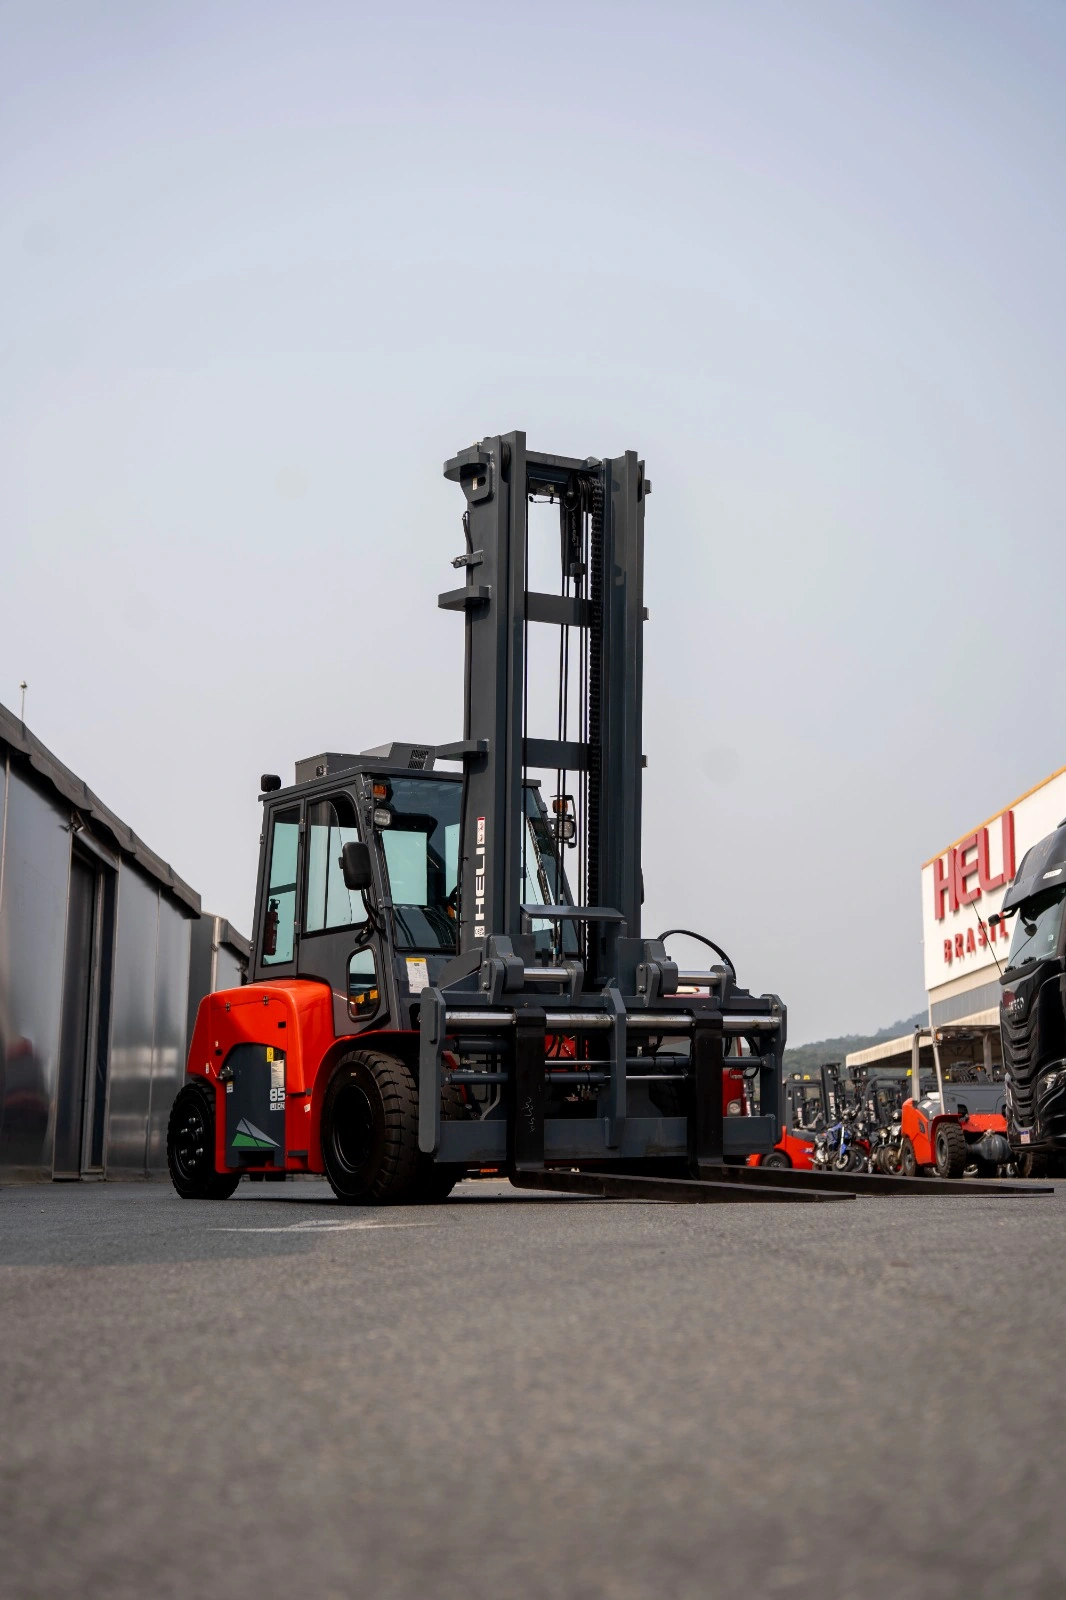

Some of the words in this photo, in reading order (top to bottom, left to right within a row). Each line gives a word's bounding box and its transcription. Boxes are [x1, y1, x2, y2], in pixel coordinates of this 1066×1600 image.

[474, 847, 485, 920] HELI
[933, 810, 1016, 920] HELI
[944, 911, 1009, 963] BRASIL
[270, 1088, 286, 1101] 85
